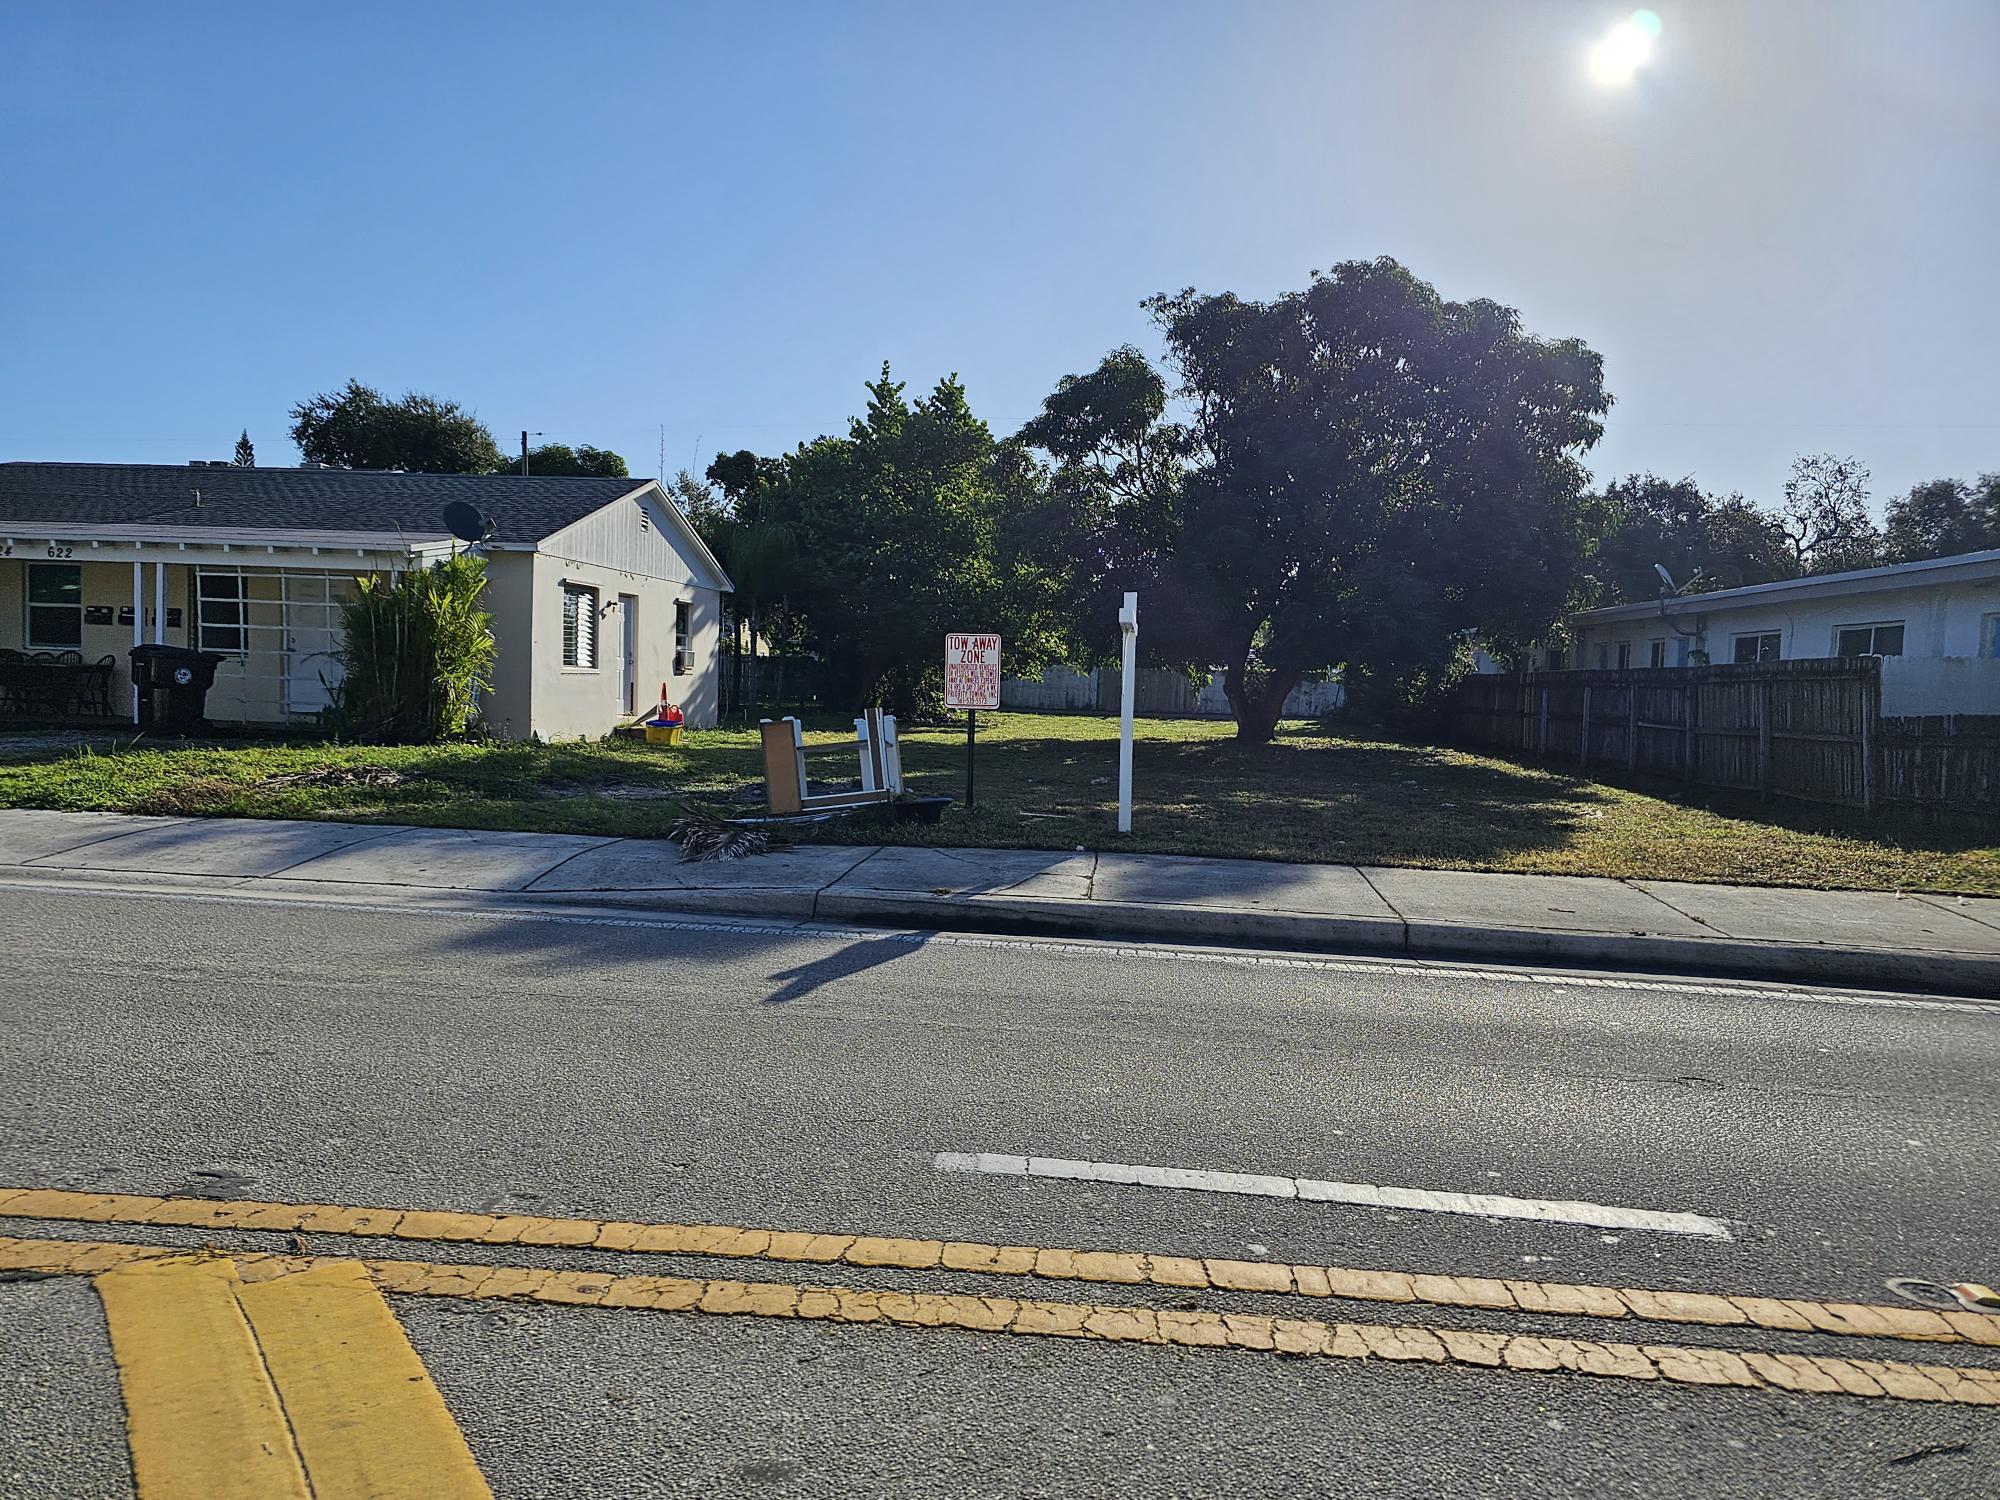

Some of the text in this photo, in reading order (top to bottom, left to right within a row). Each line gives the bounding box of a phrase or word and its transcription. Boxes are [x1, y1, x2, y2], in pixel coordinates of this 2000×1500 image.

[47, 546, 73, 558] 622
[949, 637, 998, 650] TOW AWAY
[960, 650, 986, 663] ZONE
